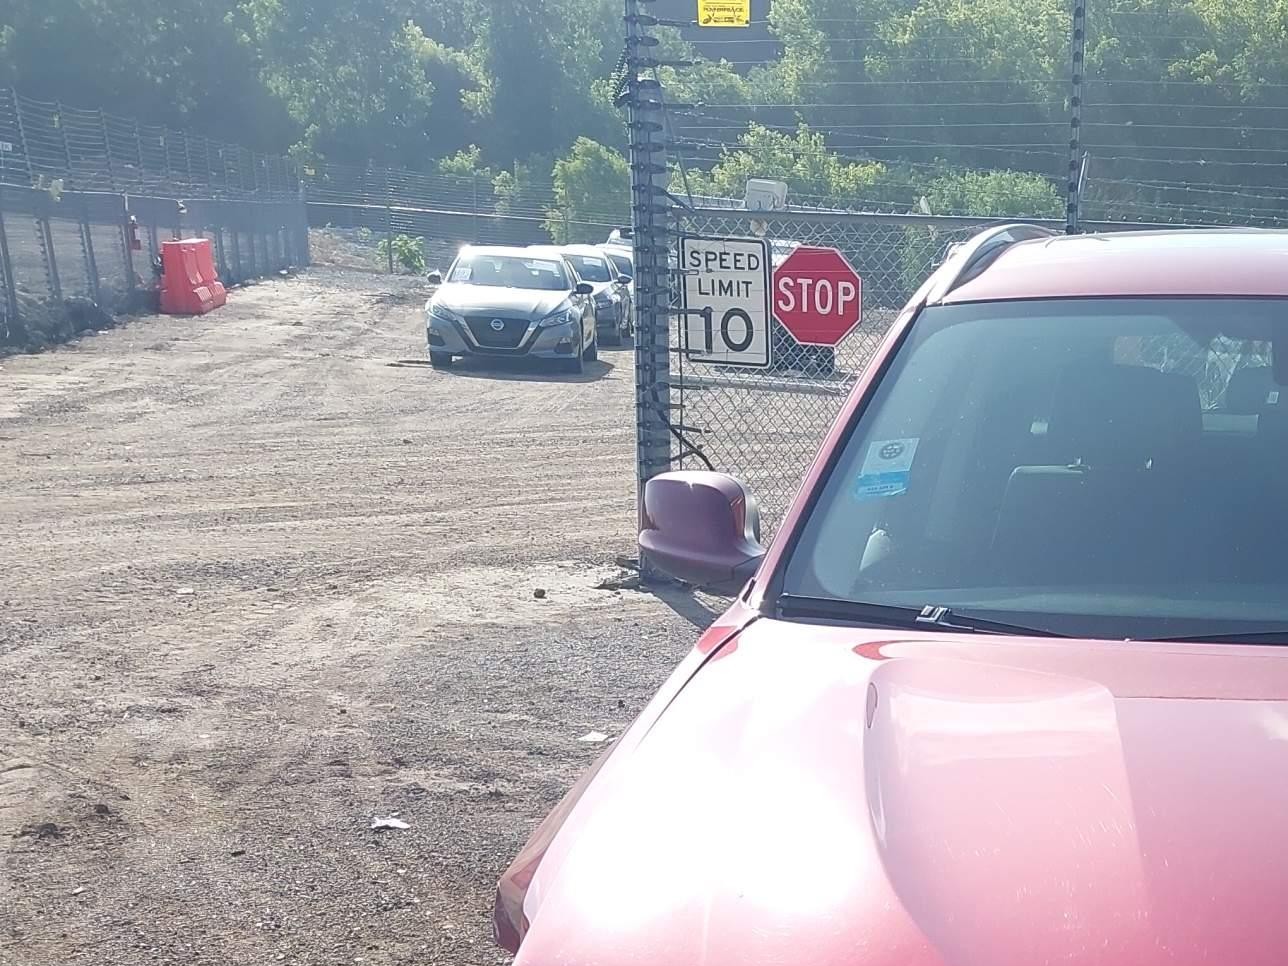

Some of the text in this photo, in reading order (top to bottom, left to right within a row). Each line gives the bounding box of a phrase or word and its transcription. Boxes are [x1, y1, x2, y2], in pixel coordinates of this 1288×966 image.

[689, 250, 760, 271] SPEED
[697, 278, 752, 298] LIMIT
[778, 277, 856, 315] STOP
[700, 307, 754, 354] 10
